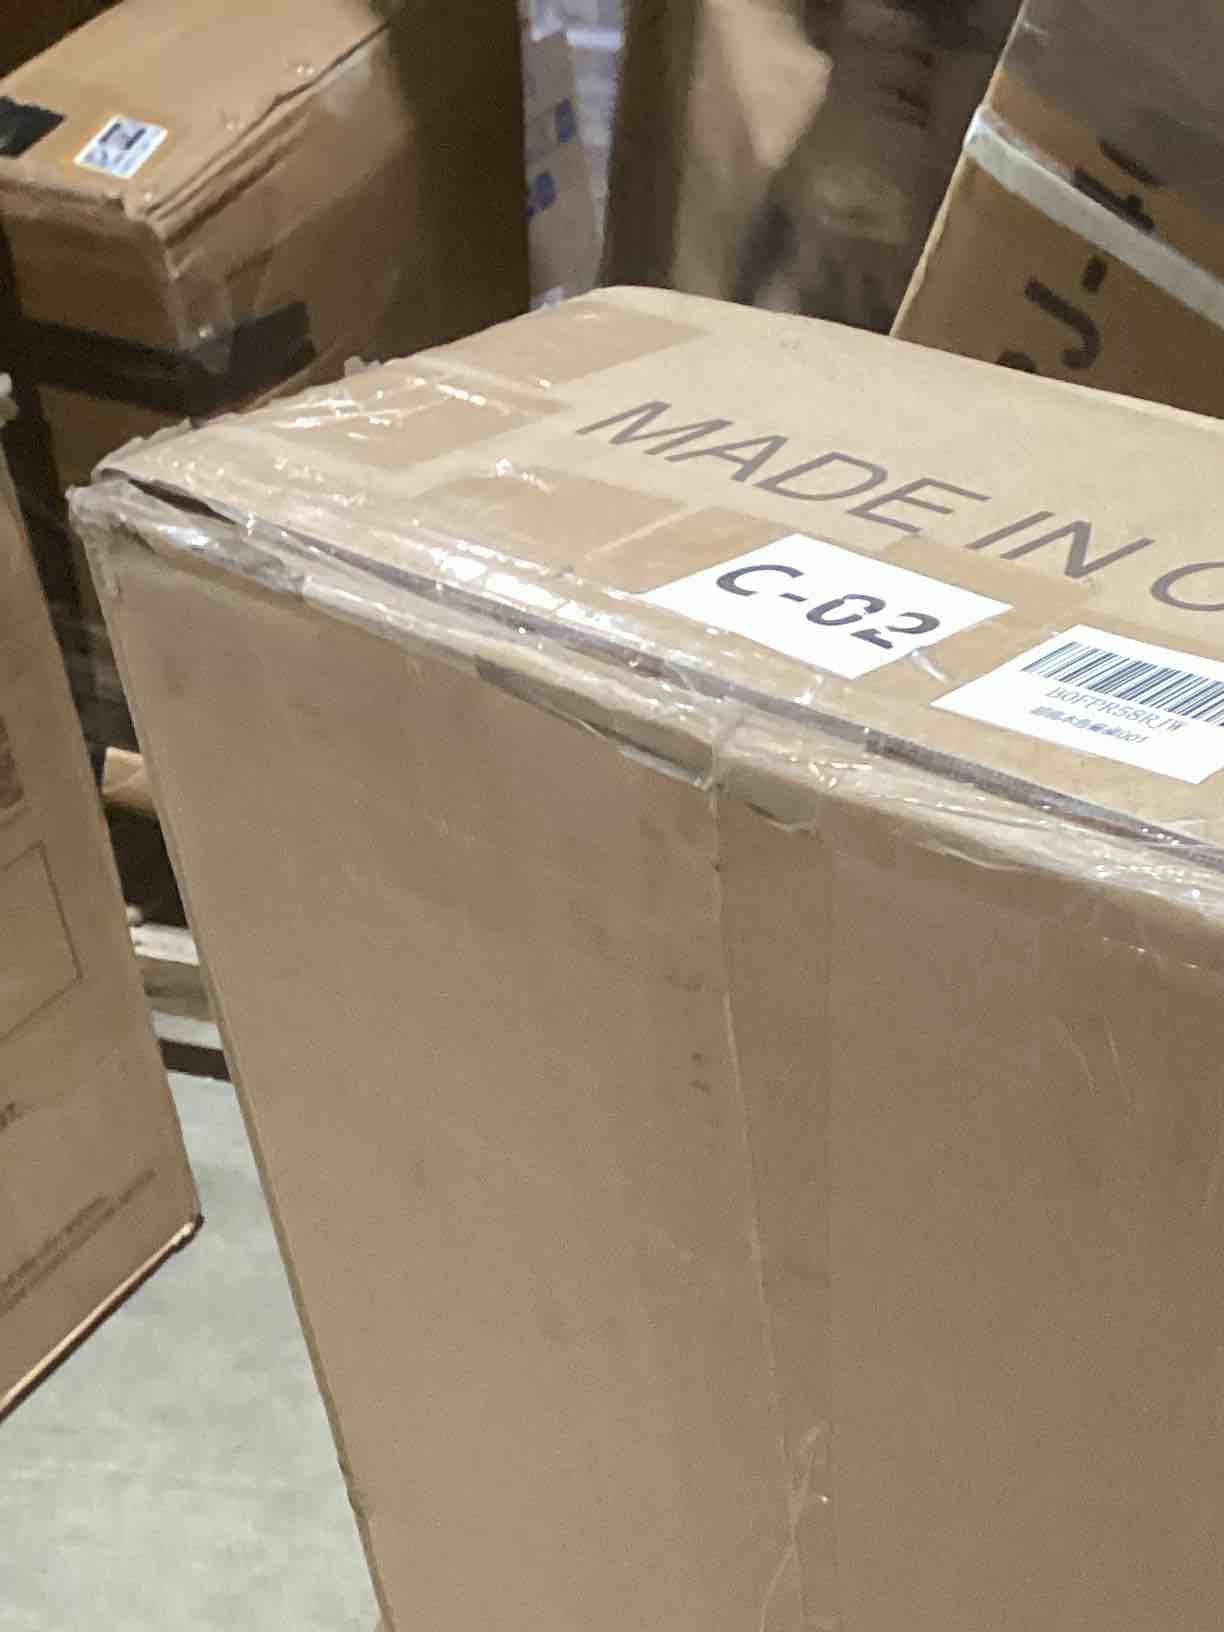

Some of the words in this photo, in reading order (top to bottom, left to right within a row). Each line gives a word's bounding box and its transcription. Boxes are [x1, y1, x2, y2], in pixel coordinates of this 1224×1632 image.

[575, 400, 991, 533] MADE
[964, 510, 1156, 579] IN
[715, 564, 941, 649] C-02
